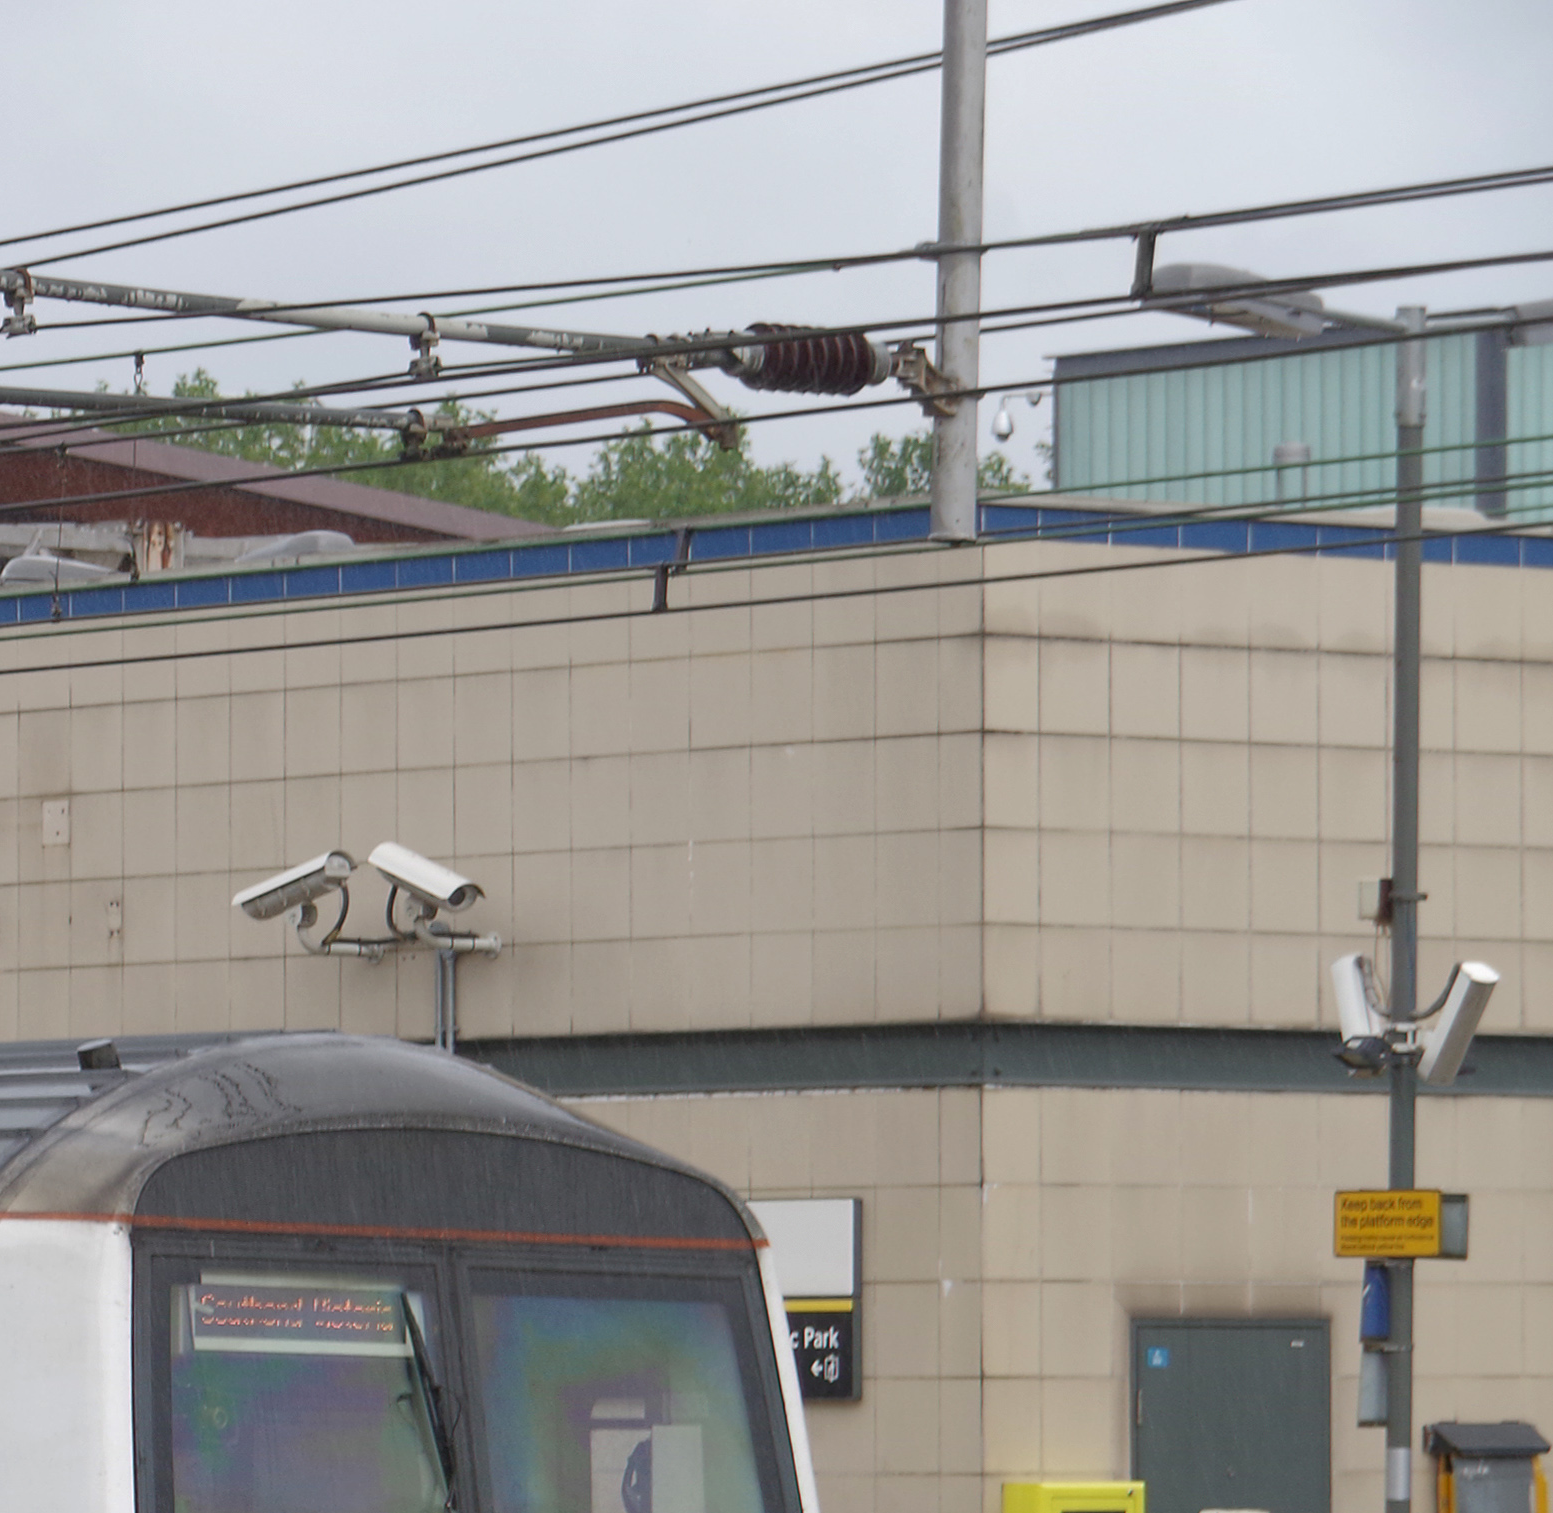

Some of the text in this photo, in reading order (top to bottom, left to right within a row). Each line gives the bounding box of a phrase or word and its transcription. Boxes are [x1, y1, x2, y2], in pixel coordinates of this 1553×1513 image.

[1341, 1197, 1422, 1212] Keep back from
[1341, 1214, 1433, 1229] the platform edge
[804, 1325, 839, 1349] Park
